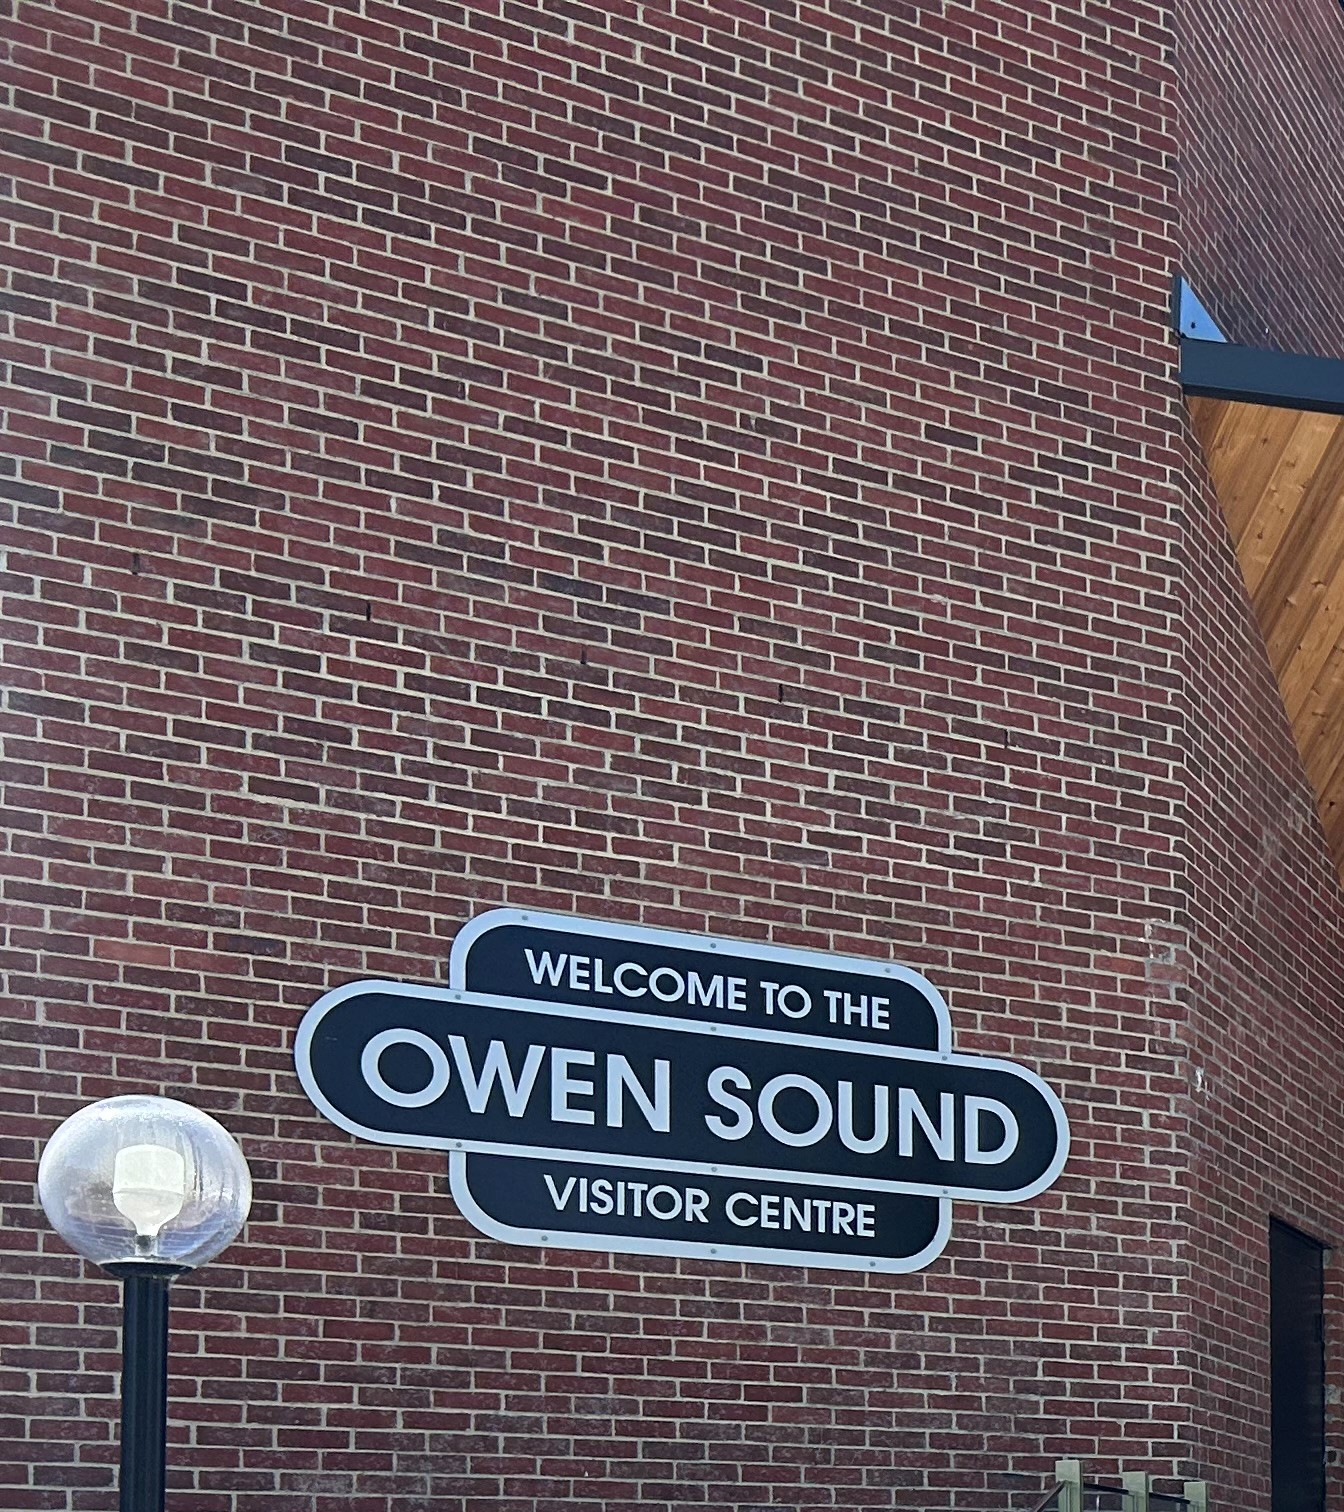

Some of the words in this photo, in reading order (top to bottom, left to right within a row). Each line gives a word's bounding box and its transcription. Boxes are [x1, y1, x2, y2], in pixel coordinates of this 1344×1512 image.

[525, 948, 748, 1012] WELCOME
[760, 981, 812, 1018] TO
[824, 991, 890, 1029] THE
[360, 1027, 671, 1132] OWEN
[704, 1066, 1019, 1165] SOUND
[544, 1174, 711, 1224] VISITOR
[725, 1191, 875, 1237] CENTRE
